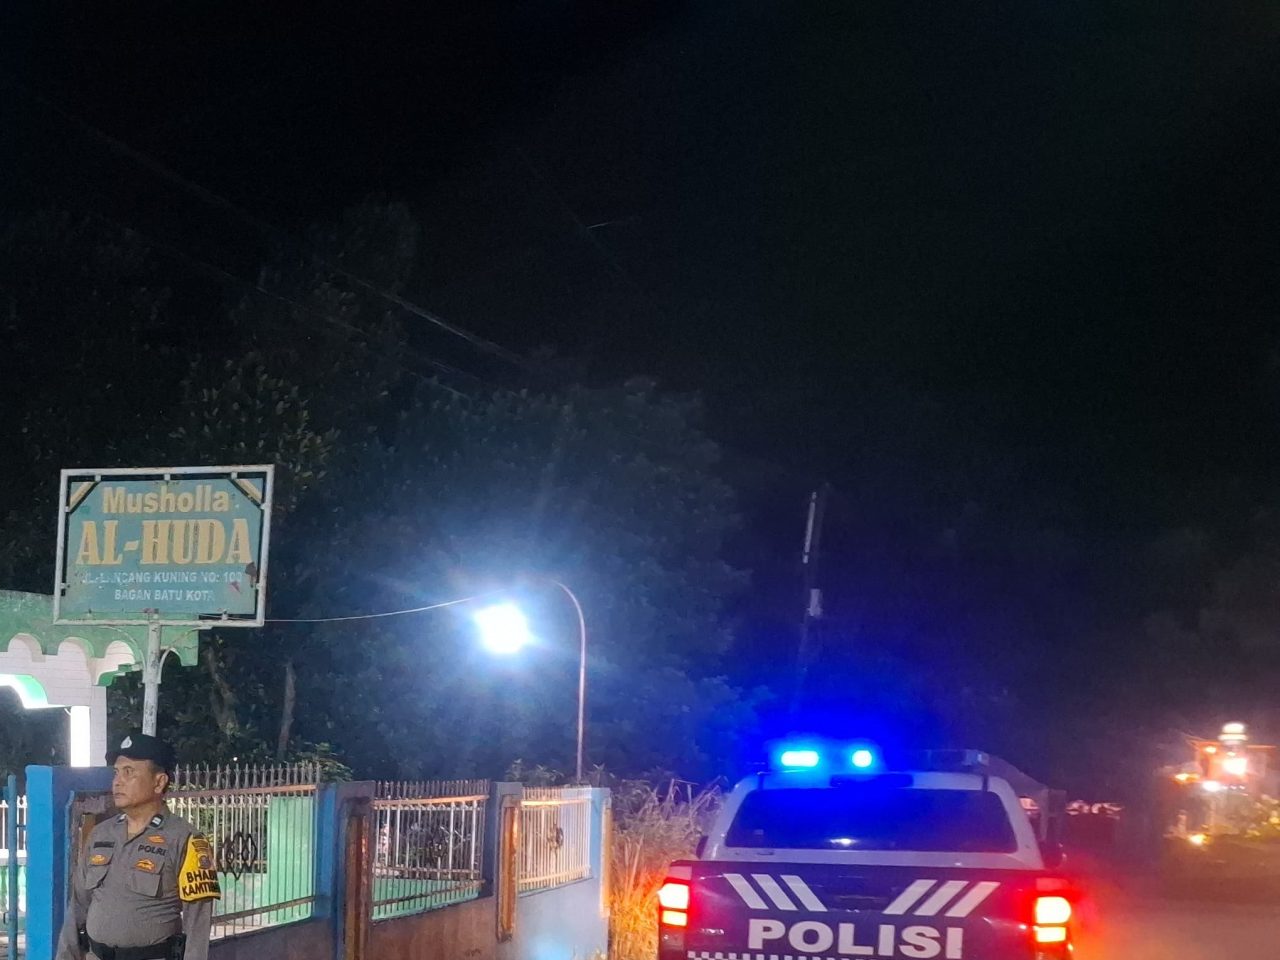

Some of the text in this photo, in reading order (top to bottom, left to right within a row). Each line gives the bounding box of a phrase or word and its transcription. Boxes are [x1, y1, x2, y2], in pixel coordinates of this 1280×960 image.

[102, 484, 229, 514] Musholla
[75, 518, 252, 565] AL-HUDA
[153, 571, 197, 583] KUNING
[114, 589, 152, 600] BAGAN
[154, 589, 183, 600] BATU
[138, 844, 167, 857] POLRI
[748, 918, 963, 960] POLISI
